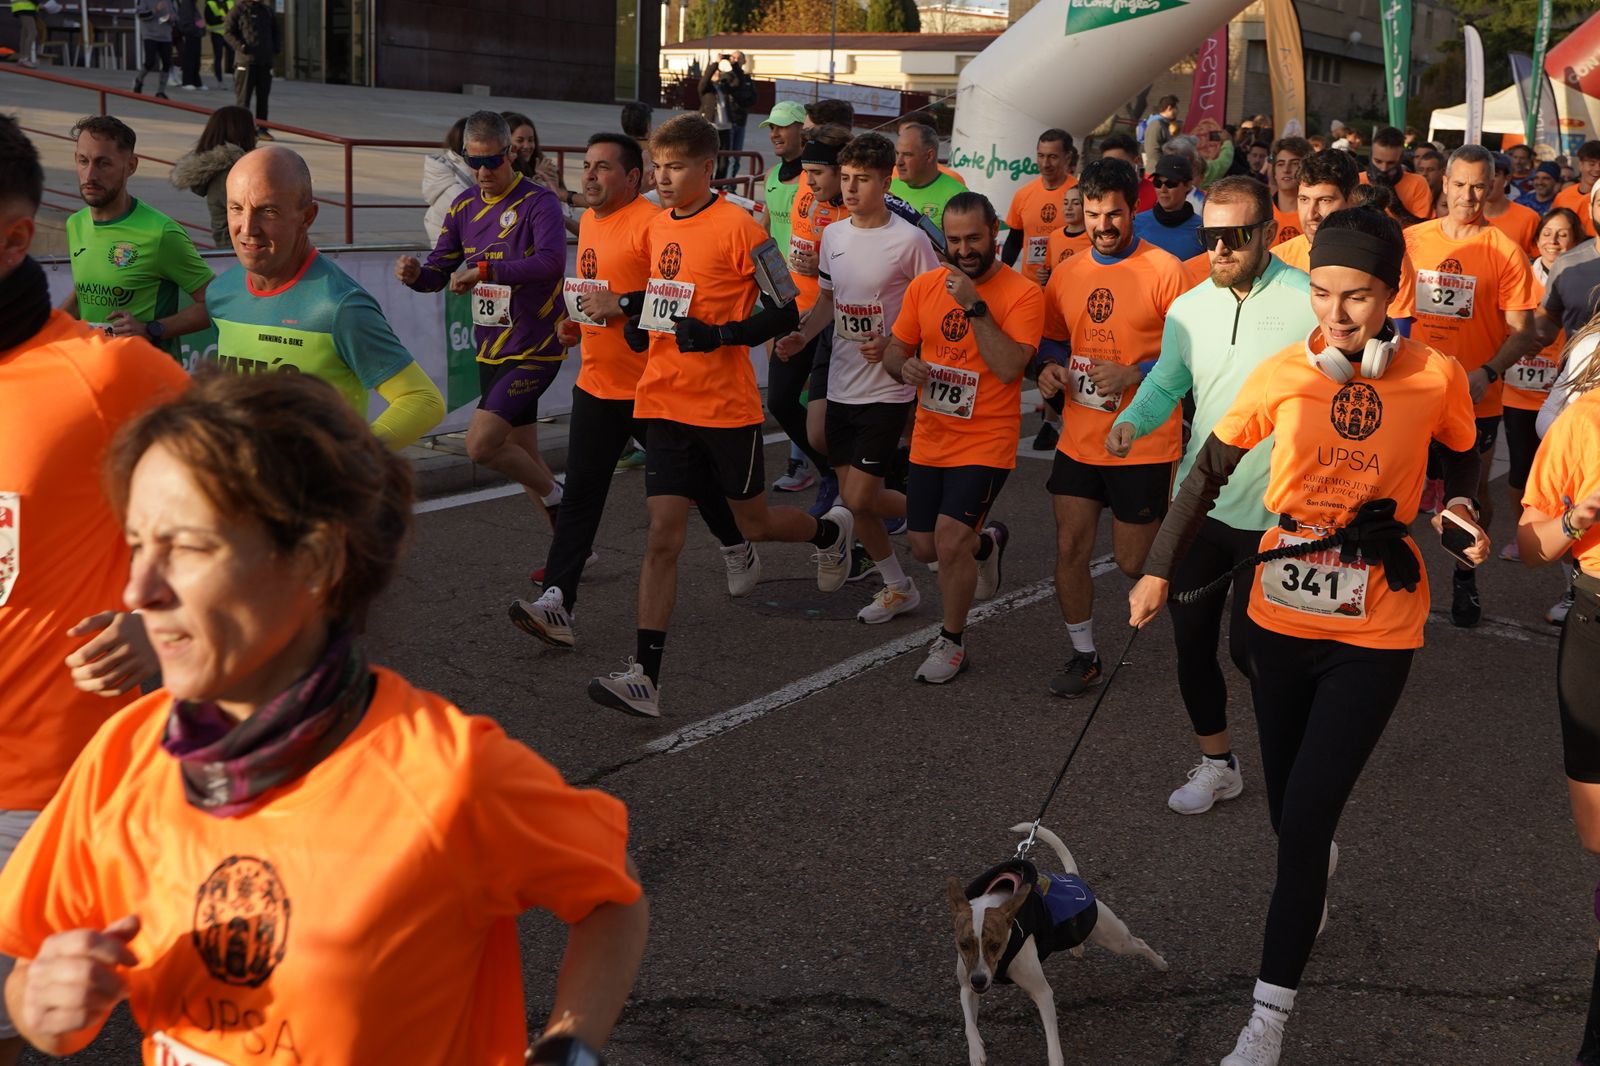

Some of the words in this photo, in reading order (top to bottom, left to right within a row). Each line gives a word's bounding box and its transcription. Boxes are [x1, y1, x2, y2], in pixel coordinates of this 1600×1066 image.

[1432, 288, 1455, 306] 32
[479, 299, 495, 316] 28
[652, 297, 679, 319] 109
[841, 315, 872, 333] 130
[258, 333, 283, 344] RUNNING
[288, 337, 304, 347] BIKE
[1083, 327, 1115, 343] UPSA
[936, 345, 968, 363] UPSA
[1517, 367, 1545, 383] 191
[930, 381, 962, 405] 178
[1317, 446, 1380, 475] UPSA
[1281, 563, 1340, 600] 341
[181, 997, 304, 1065] UPSA
